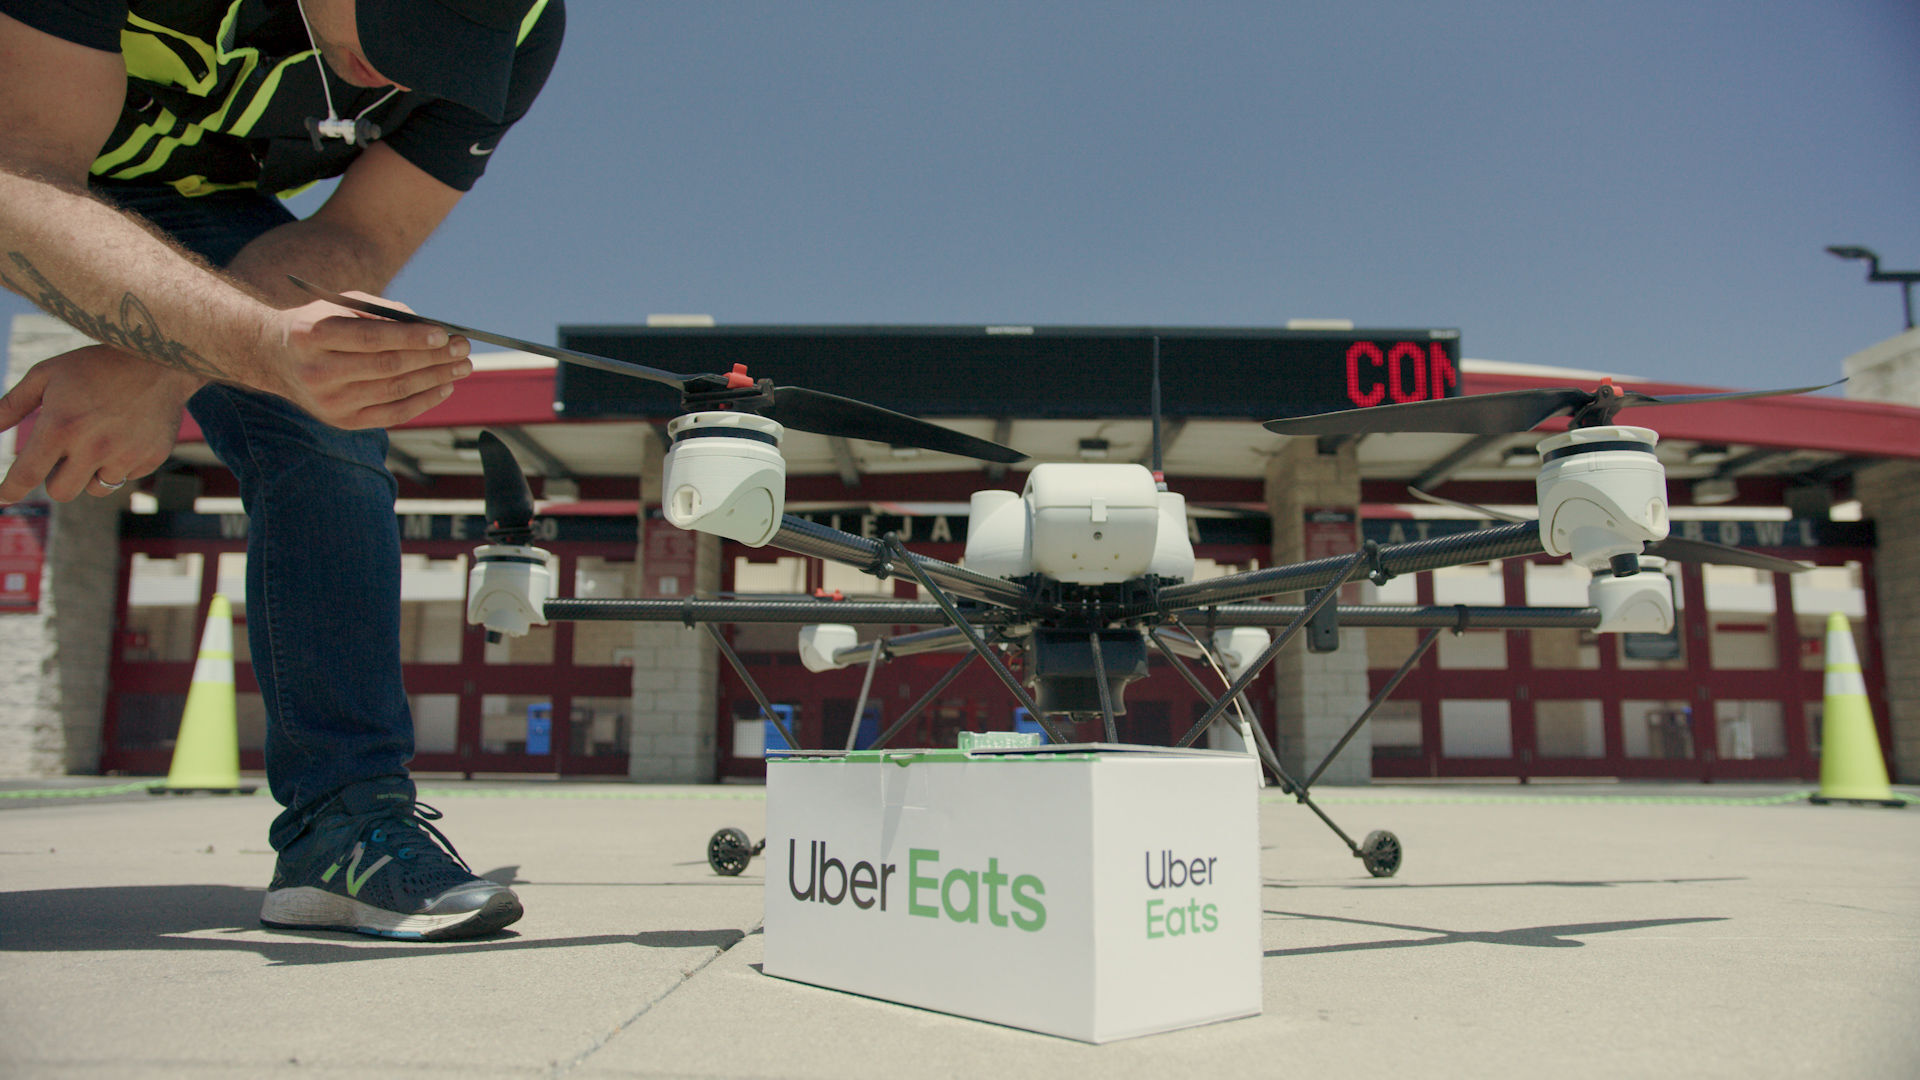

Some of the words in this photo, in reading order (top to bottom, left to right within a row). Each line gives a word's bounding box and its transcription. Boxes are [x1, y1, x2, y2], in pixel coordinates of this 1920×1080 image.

[1346, 341, 1457, 407] CON
[1682, 519, 1819, 547] BOWL
[788, 838, 896, 912] Uber
[908, 848, 1047, 932] Eats
[1145, 849, 1218, 890] Uber
[1146, 897, 1219, 940] Eats
